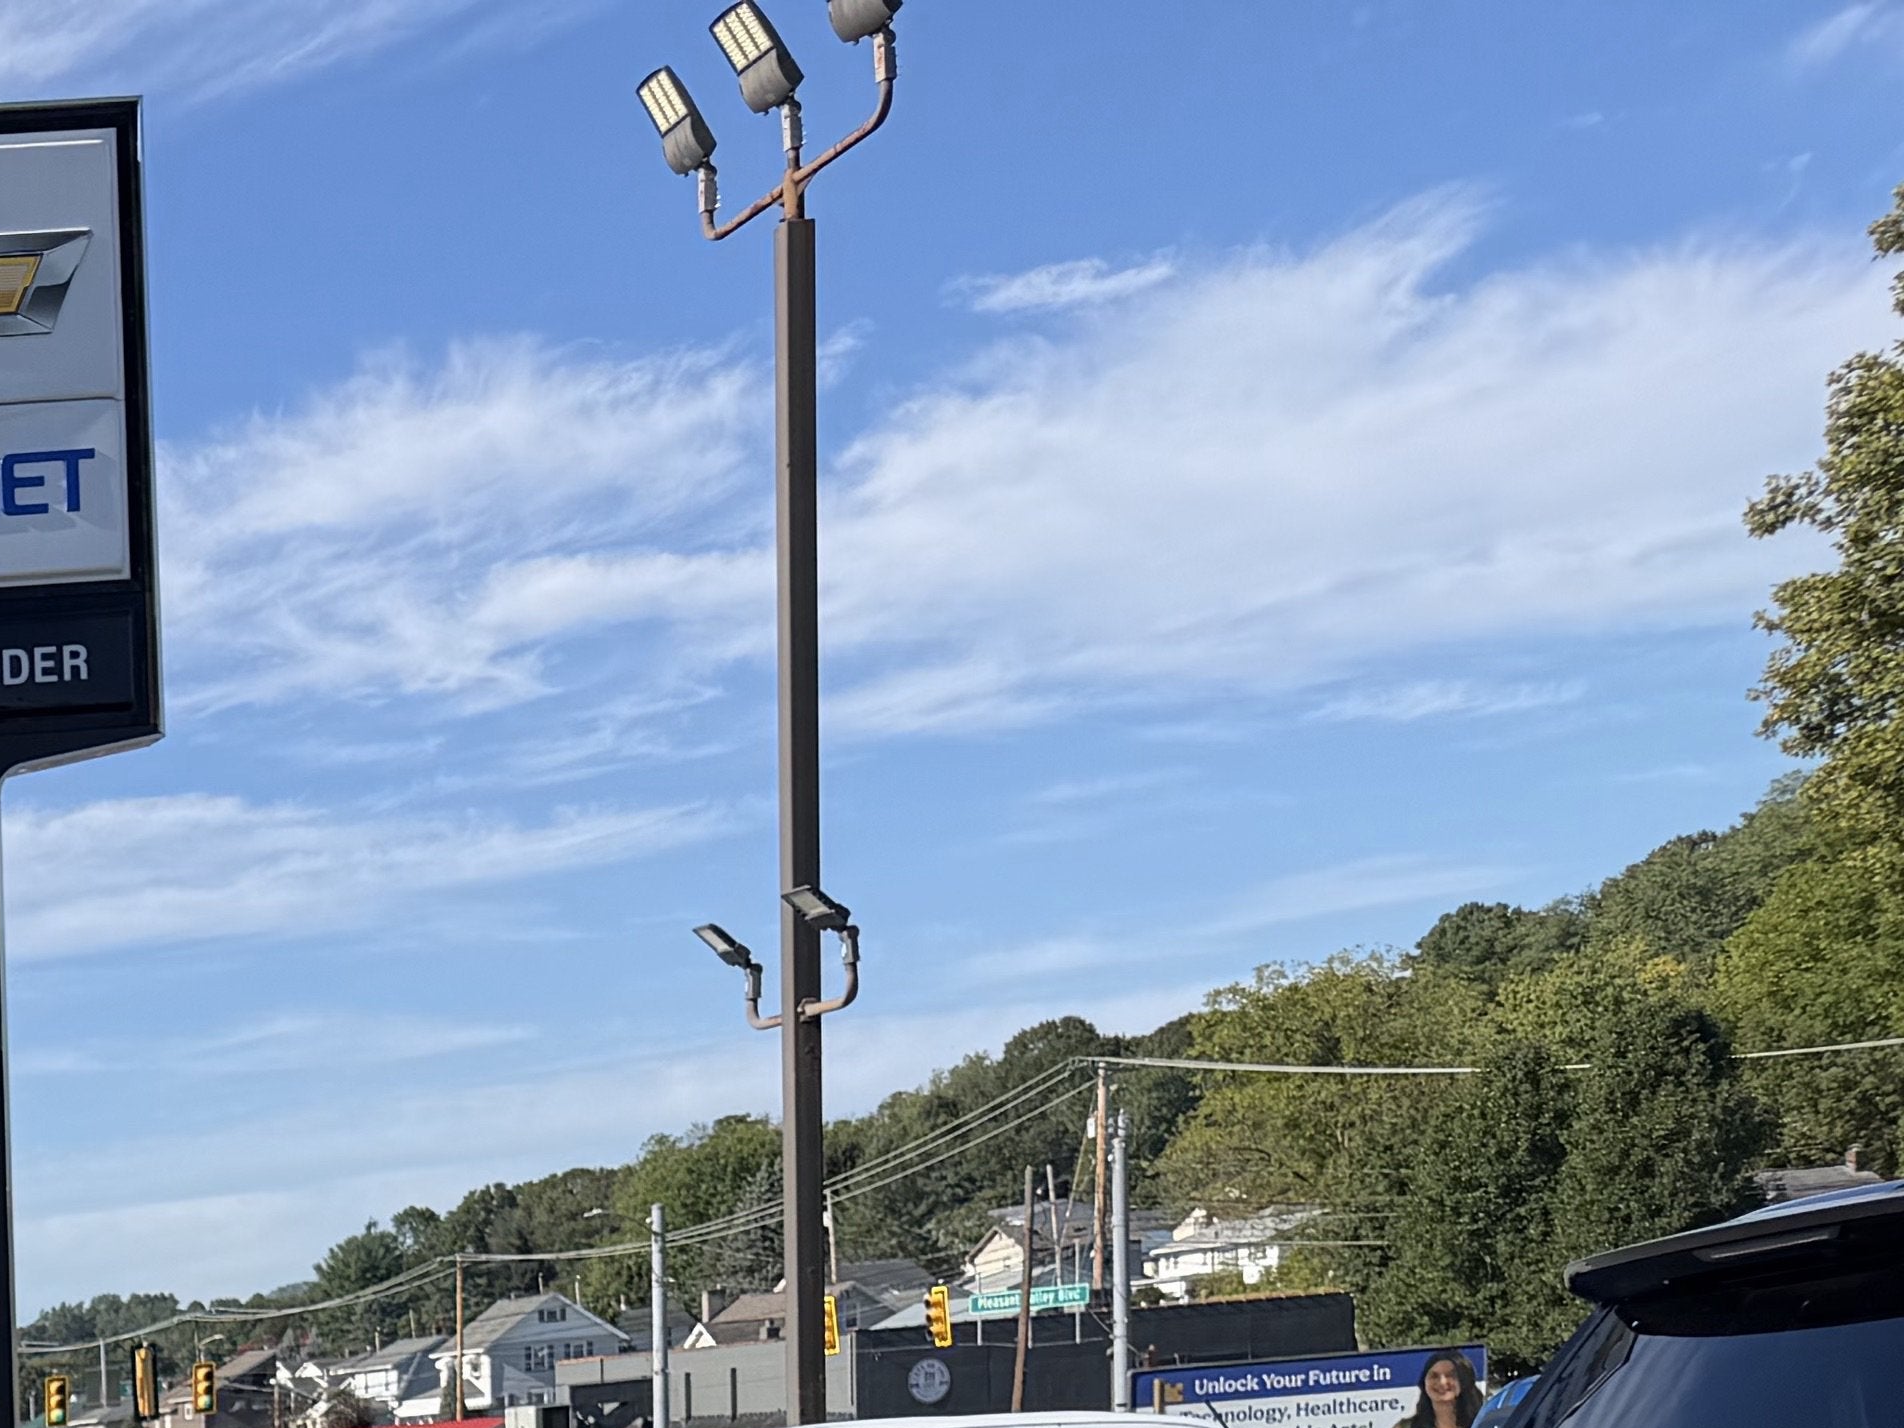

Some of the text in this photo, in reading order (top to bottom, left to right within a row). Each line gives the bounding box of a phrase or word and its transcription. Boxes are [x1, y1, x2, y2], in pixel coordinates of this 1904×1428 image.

[977, 1294, 1020, 1310] Pleasant
[1194, 1373, 1259, 1396] Unlock
[1262, 1371, 1306, 1391] Your
[1308, 1367, 1370, 1386] Future
[1295, 1397, 1406, 1417] Healthcare,
